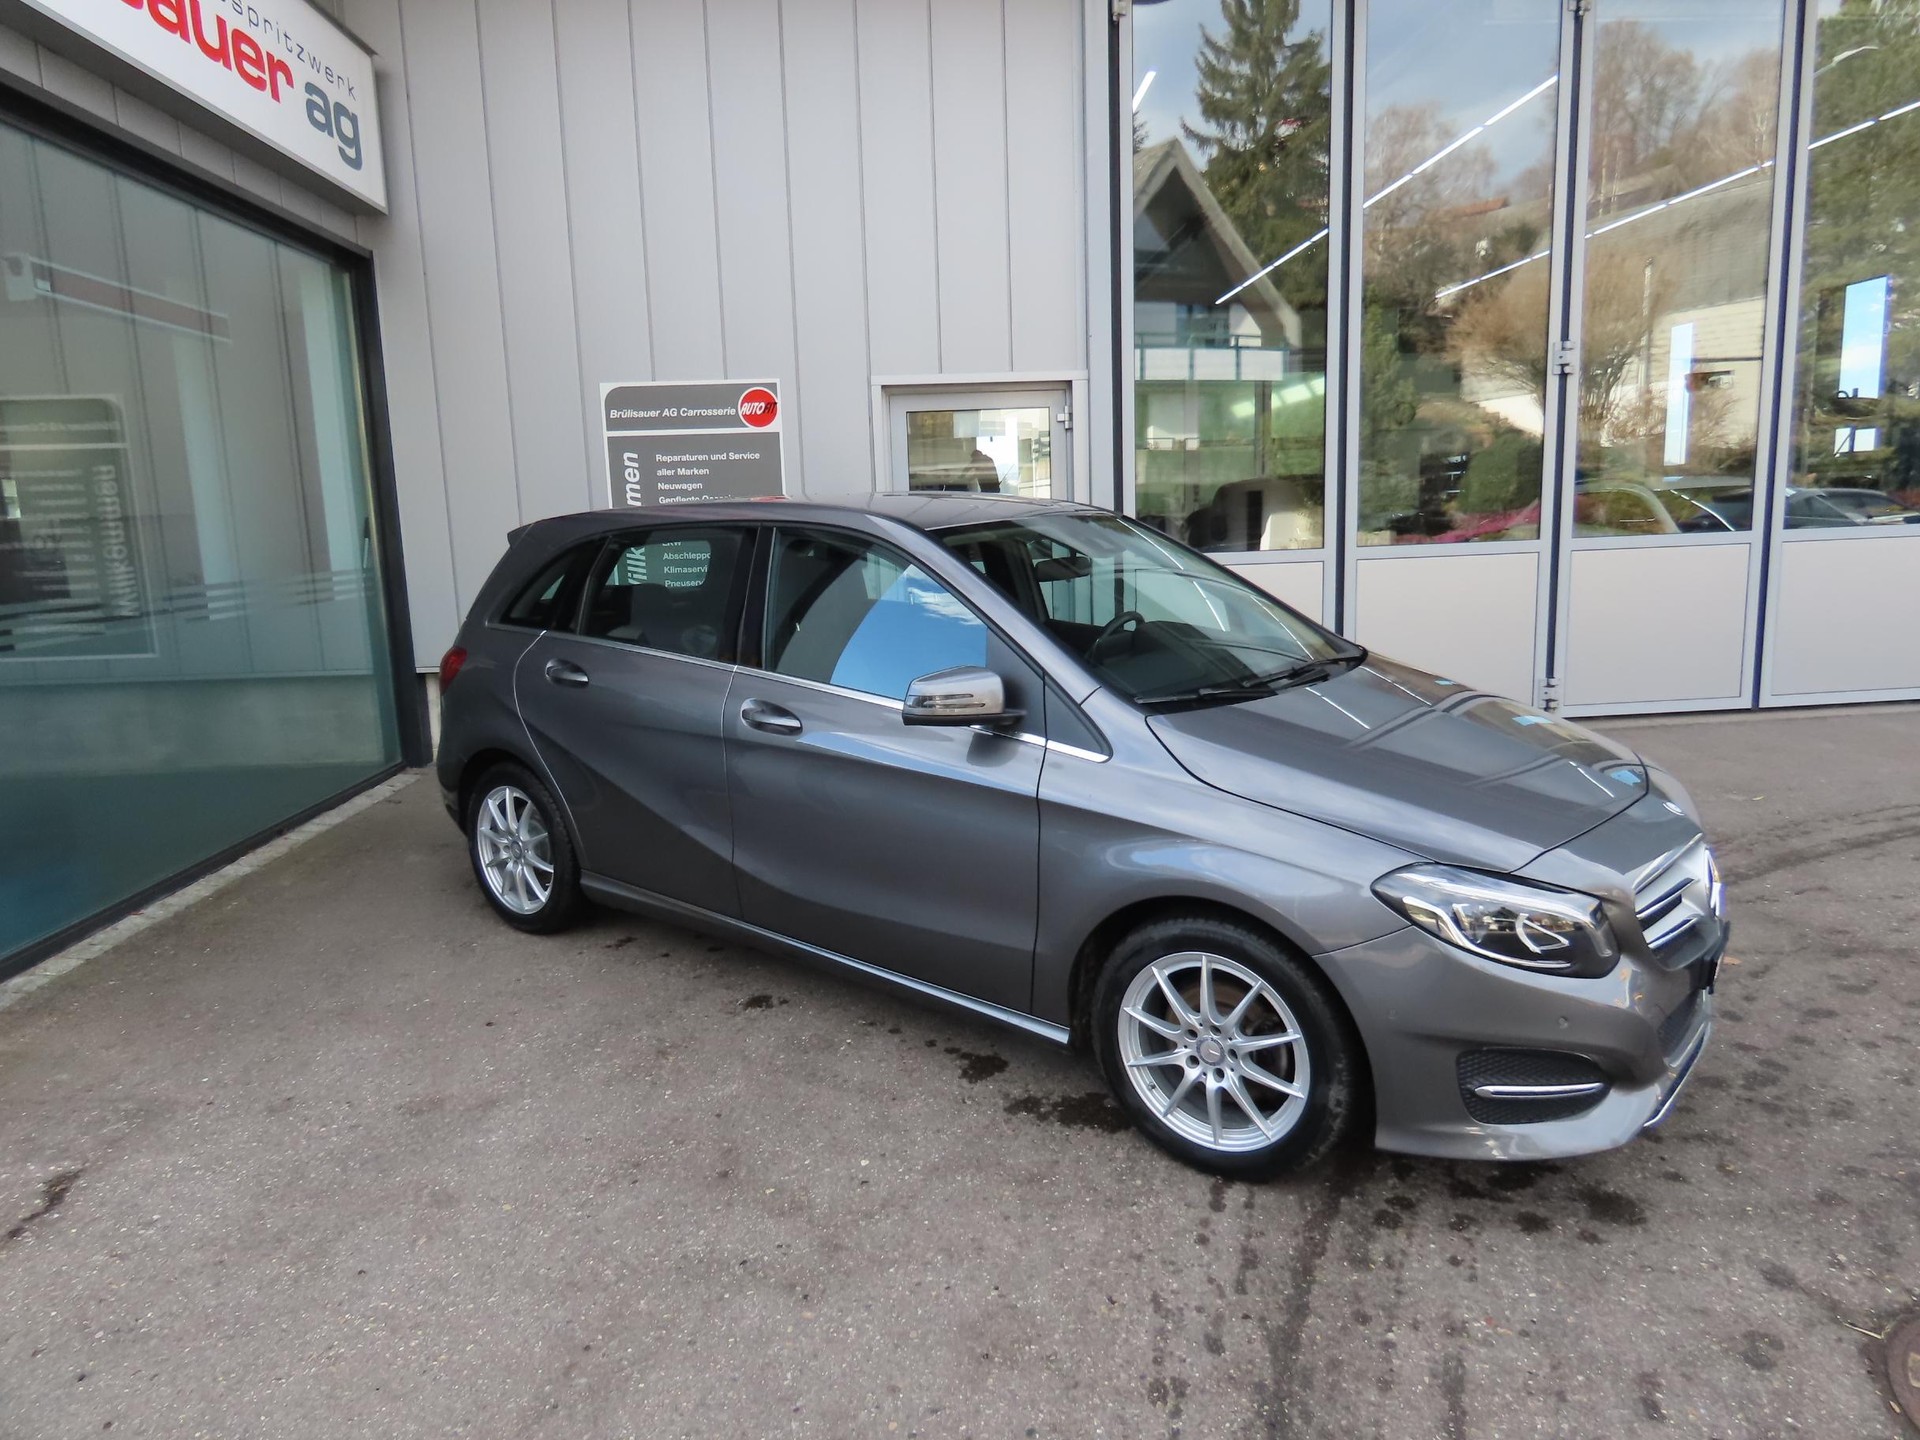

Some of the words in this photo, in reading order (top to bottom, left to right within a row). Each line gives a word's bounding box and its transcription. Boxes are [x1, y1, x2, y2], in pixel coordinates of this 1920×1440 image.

[221, 0, 357, 101] spritzwerk
[119, 0, 294, 103] auer
[304, 82, 364, 172] ag
[610, 409, 660, 418] Brülisauer
[662, 407, 678, 417] AG
[681, 407, 736, 417] Carrosserie
[656, 454, 708, 463] Reparaturen
[728, 452, 760, 460] Service
[656, 468, 675, 476] aller
[677, 467, 709, 476] Marken
[657, 482, 703, 491] Neuwagen
